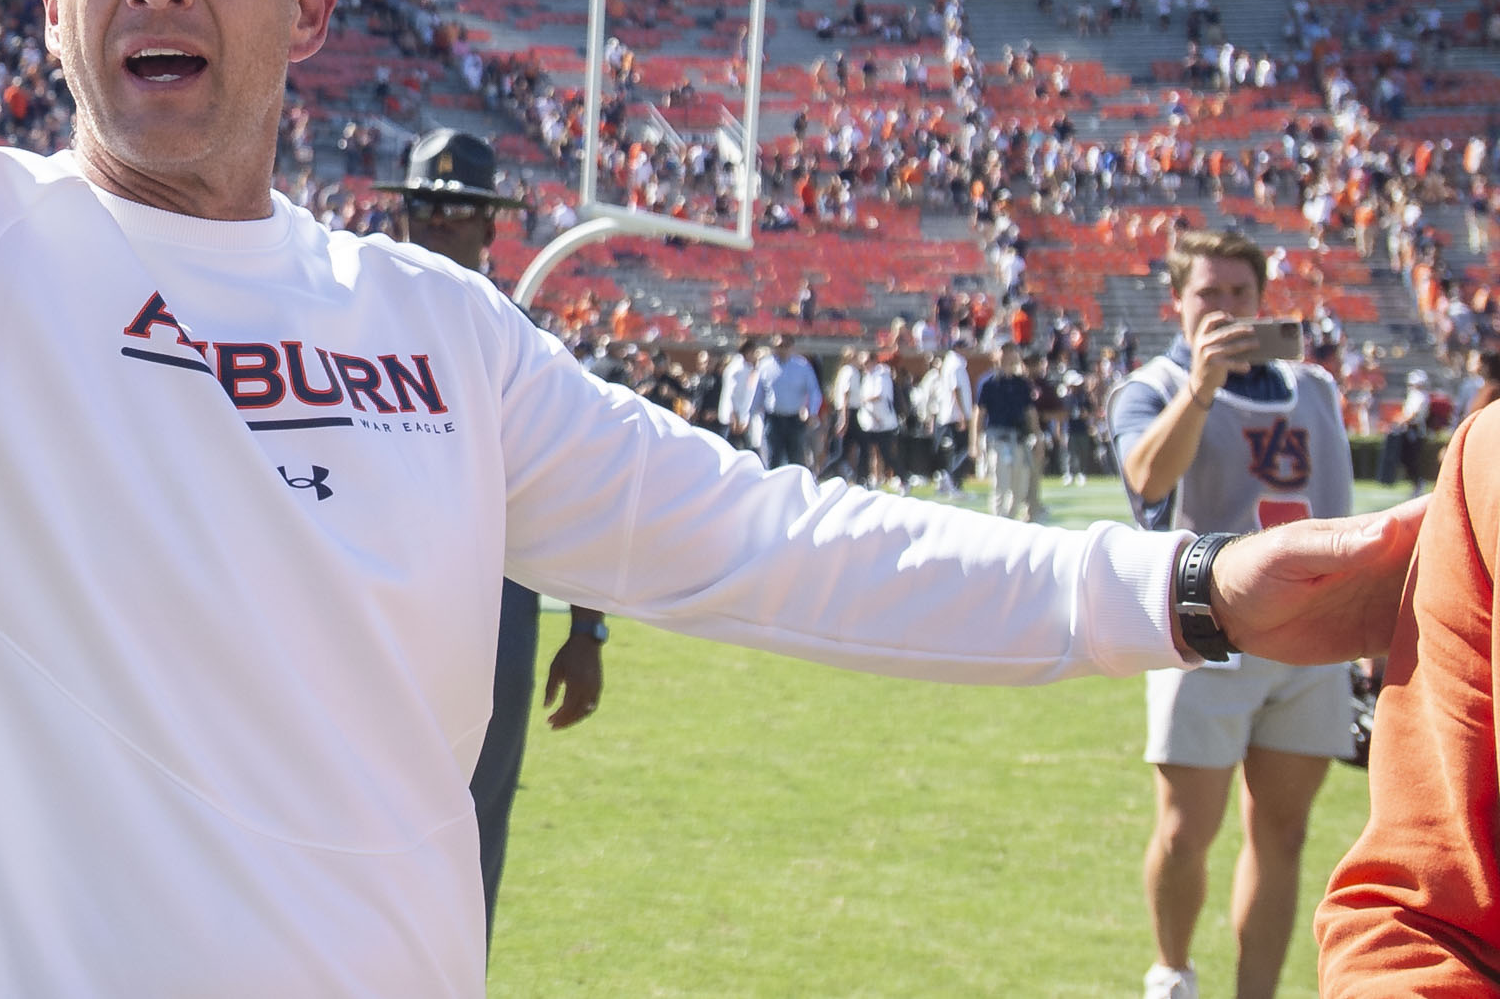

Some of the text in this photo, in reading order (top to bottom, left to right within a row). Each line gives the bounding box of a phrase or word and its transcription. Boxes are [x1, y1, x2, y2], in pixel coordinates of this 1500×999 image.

[123, 290, 449, 415] ABURN
[359, 418, 456, 435] WAR EAGLE
